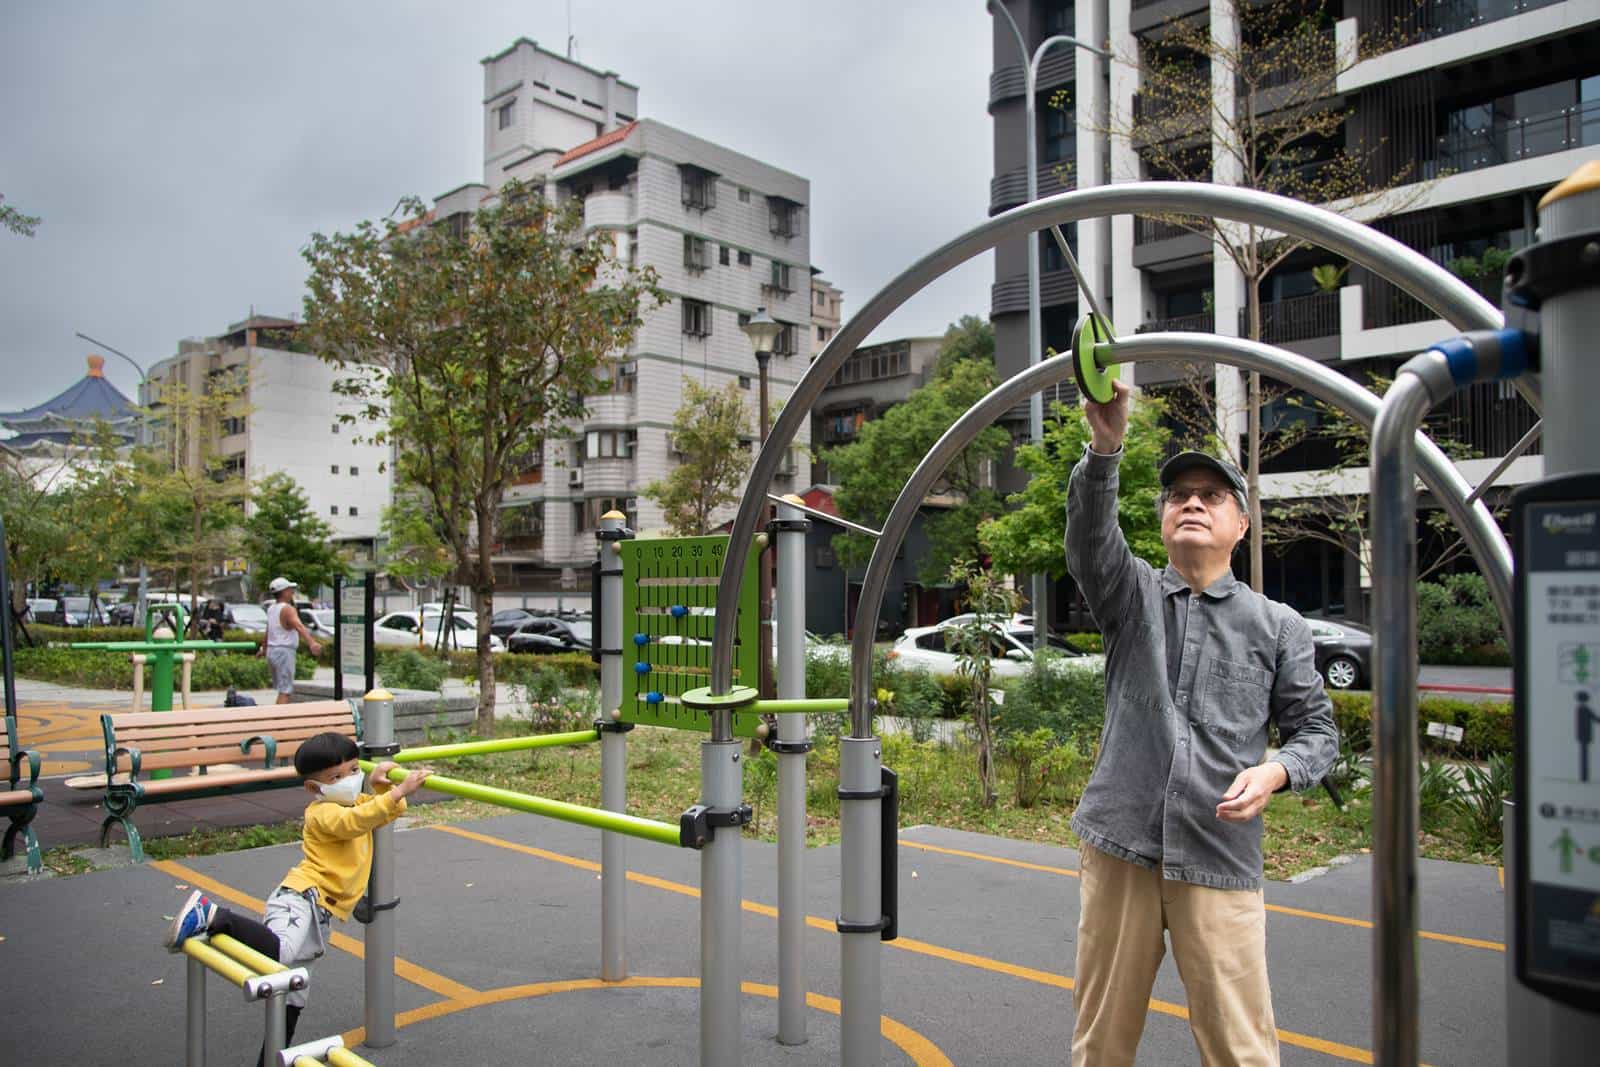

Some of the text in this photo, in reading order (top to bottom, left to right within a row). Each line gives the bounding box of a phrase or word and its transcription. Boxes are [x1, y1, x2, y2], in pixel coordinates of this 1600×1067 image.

[636, 544, 722, 559] 0 10 20 30 40
